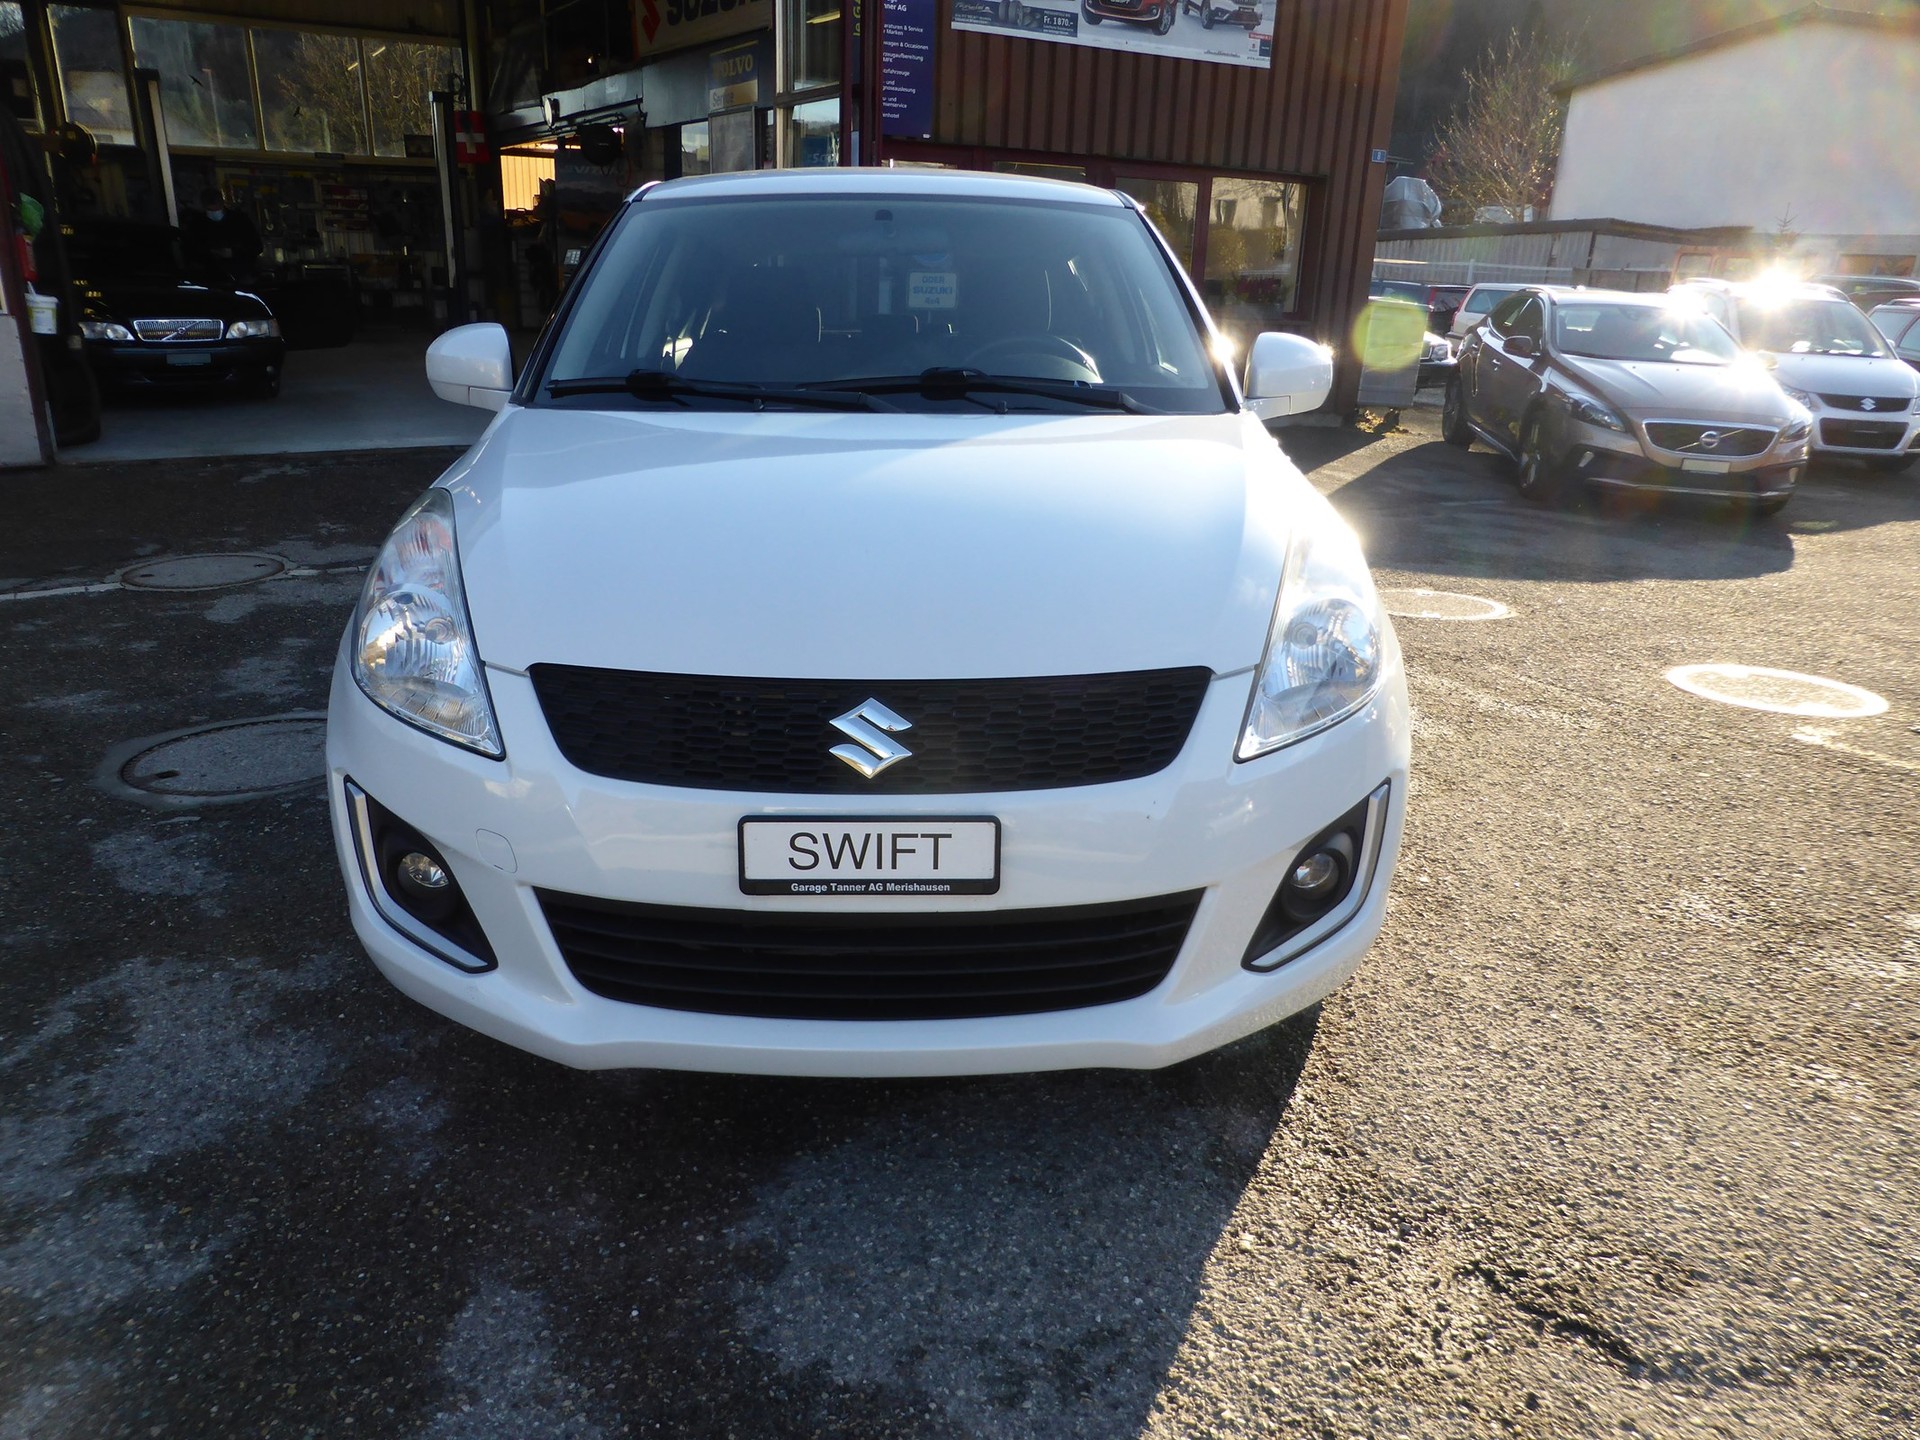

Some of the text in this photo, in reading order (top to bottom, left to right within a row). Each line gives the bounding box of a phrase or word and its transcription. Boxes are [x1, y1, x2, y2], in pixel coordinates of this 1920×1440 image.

[897, 4, 907, 12] AG
[1043, 15, 1052, 24] Fr.
[904, 42, 929, 50] Occasionen
[913, 286, 953, 295] SUZUKI
[788, 831, 953, 871] SWIFT
[790, 882, 951, 894] Garage Tanner AG Merishausen
